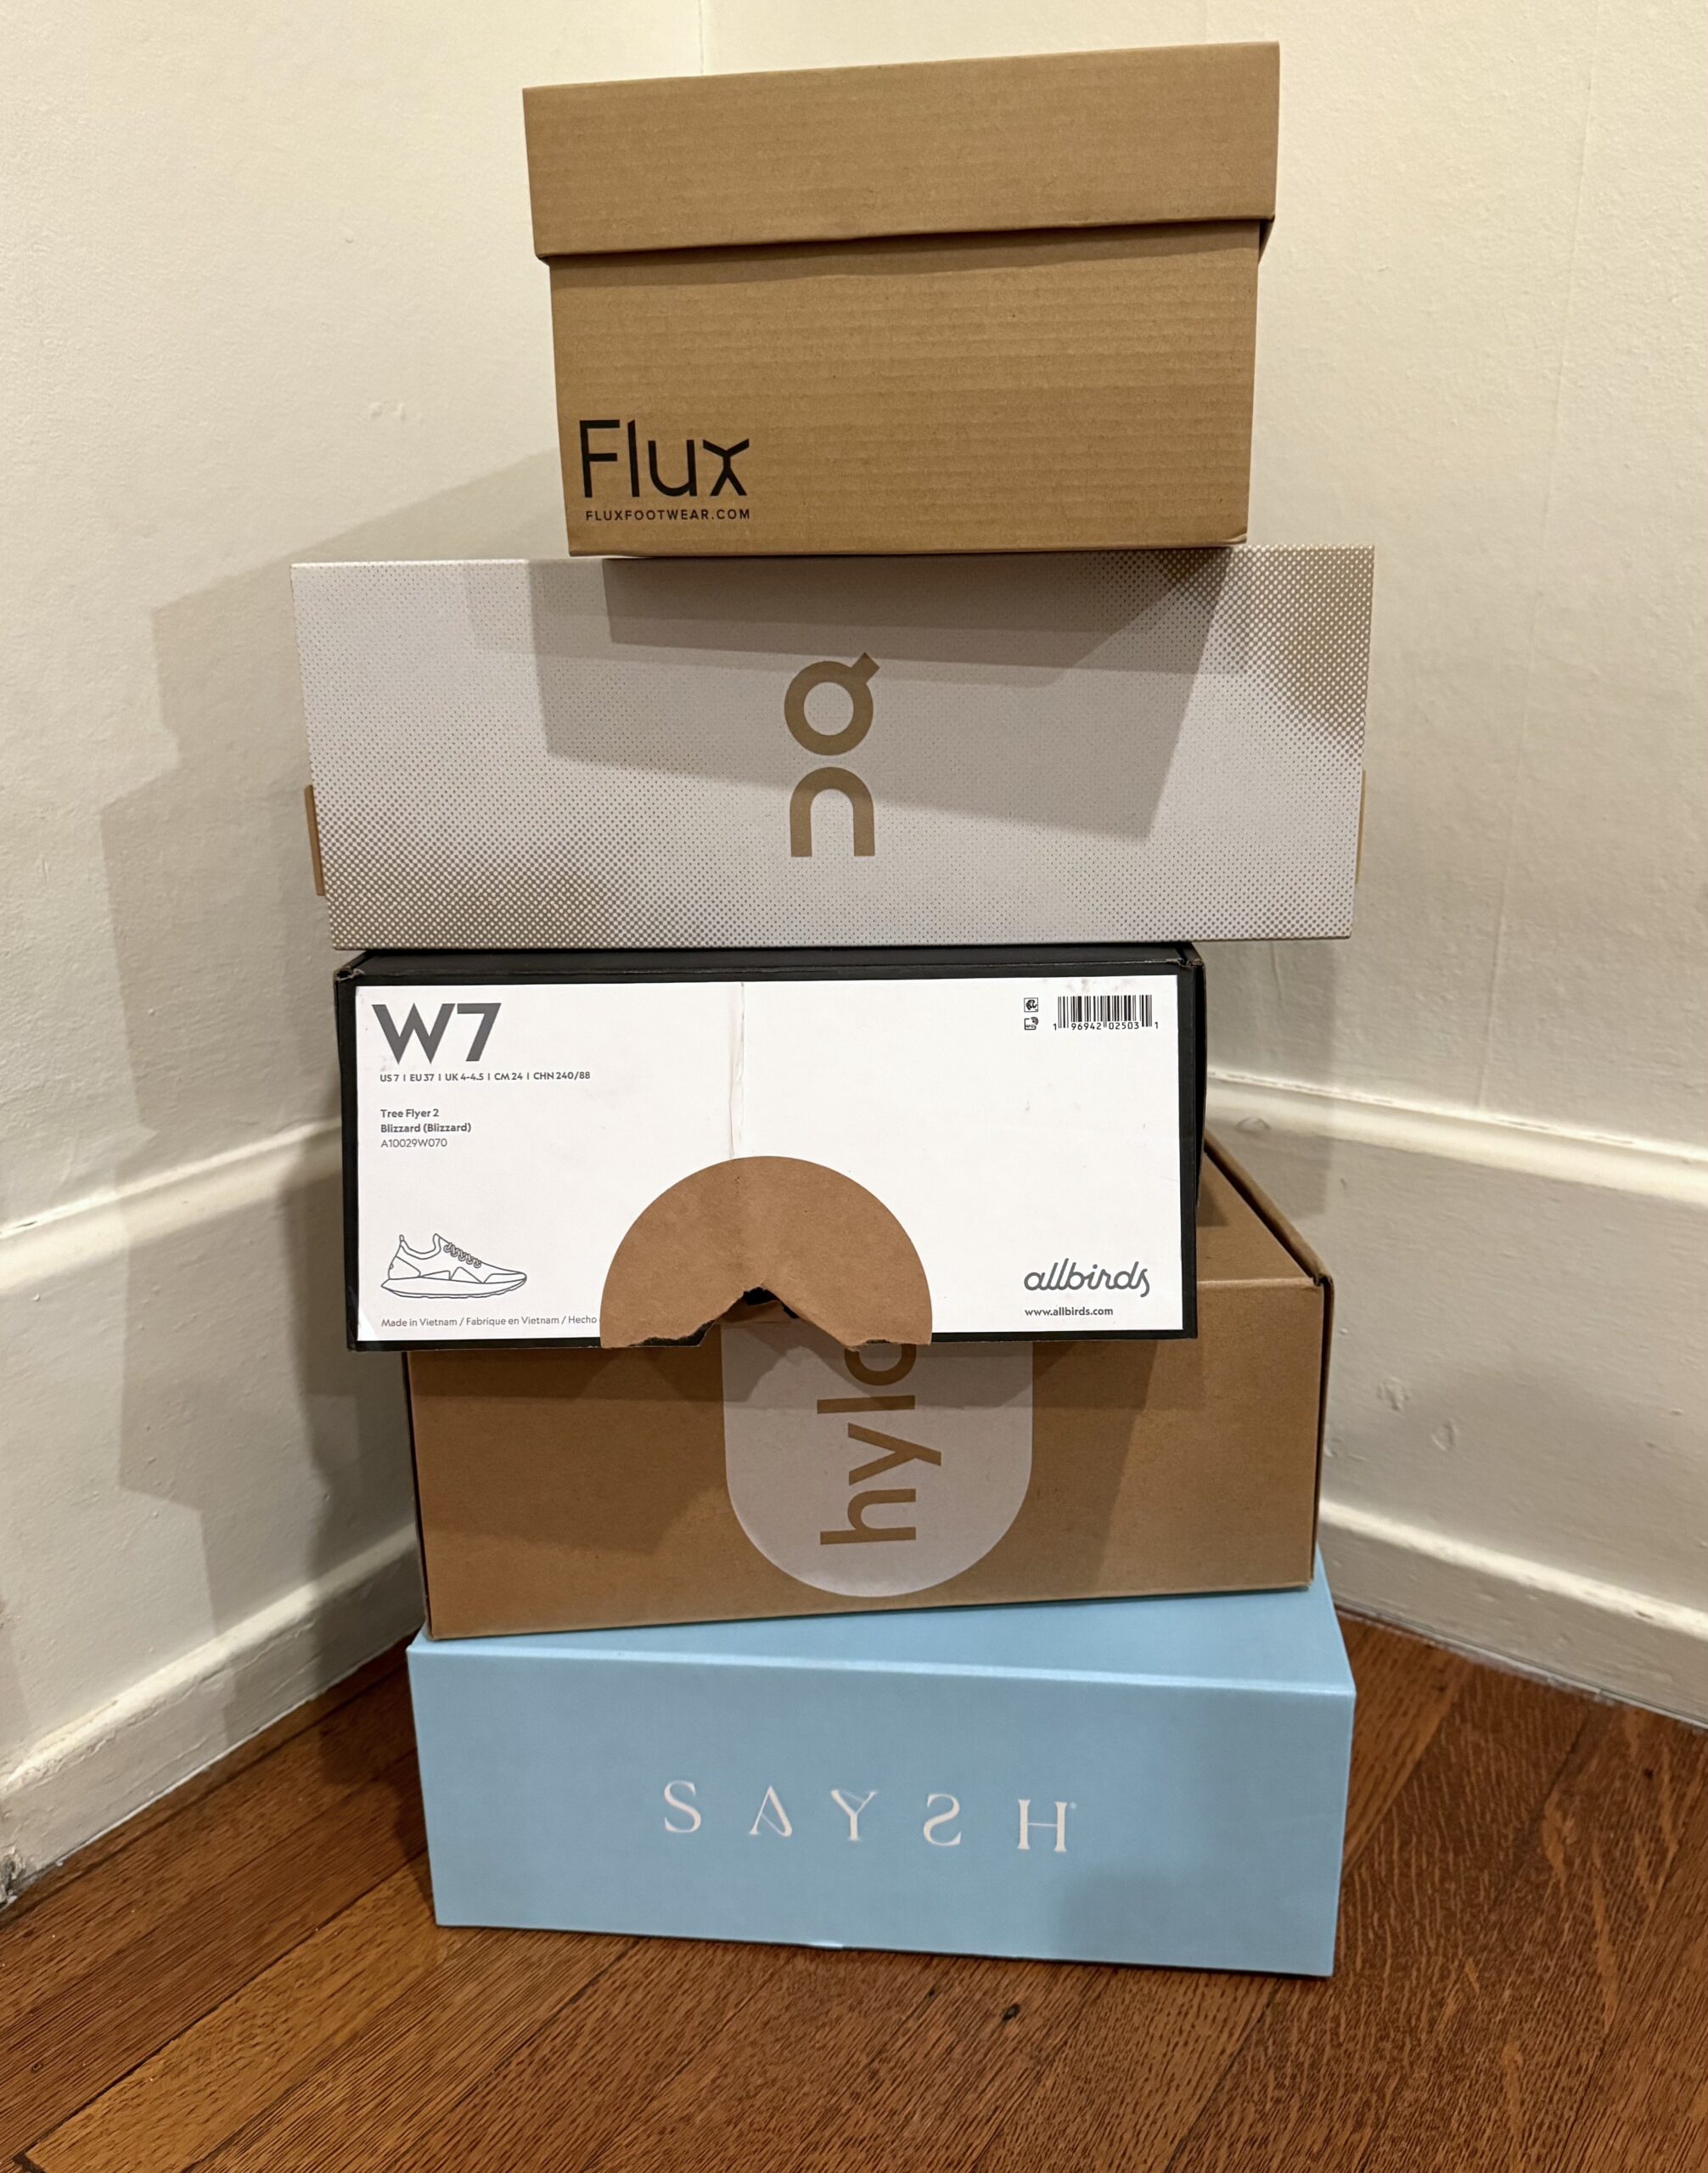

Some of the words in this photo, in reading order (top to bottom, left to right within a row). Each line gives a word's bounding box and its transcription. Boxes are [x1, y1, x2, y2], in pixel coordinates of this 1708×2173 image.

[579, 419, 750, 498] Flux
[586, 508, 750, 521] FLUXFOOTWEAR.COM
[371, 1002, 502, 1064] W7
[379, 1074, 392, 1082] US
[393, 1074, 399, 1082] 7
[409, 1074, 422, 1082] EU
[423, 1073, 435, 1081] 37
[445, 1073, 459, 1081] UK
[460, 1072, 484, 1081] 4-4.5
[494, 1072, 510, 1081] CM
[555, 1071, 591, 1080] 240/88
[380, 1109, 404, 1118] Tree
[405, 1109, 431, 1119] Flyer
[433, 1109, 439, 1117] 2
[380, 1124, 421, 1132] Blizzard
[423, 1122, 472, 1133] (Blizzard)
[380, 1138, 447, 1148] A10029W070
[1024, 1257, 1150, 1298] allbirds
[1025, 1306, 1114, 1317] www.allbirds.com
[381, 1317, 407, 1327] Made
[419, 1317, 458, 1326] Vietnam
[466, 1317, 507, 1327] Fabrique
[521, 1317, 559, 1325] Vietnam
[568, 1315, 598, 1324] Hecho
[663, 1779, 1068, 1852] SAYSH
